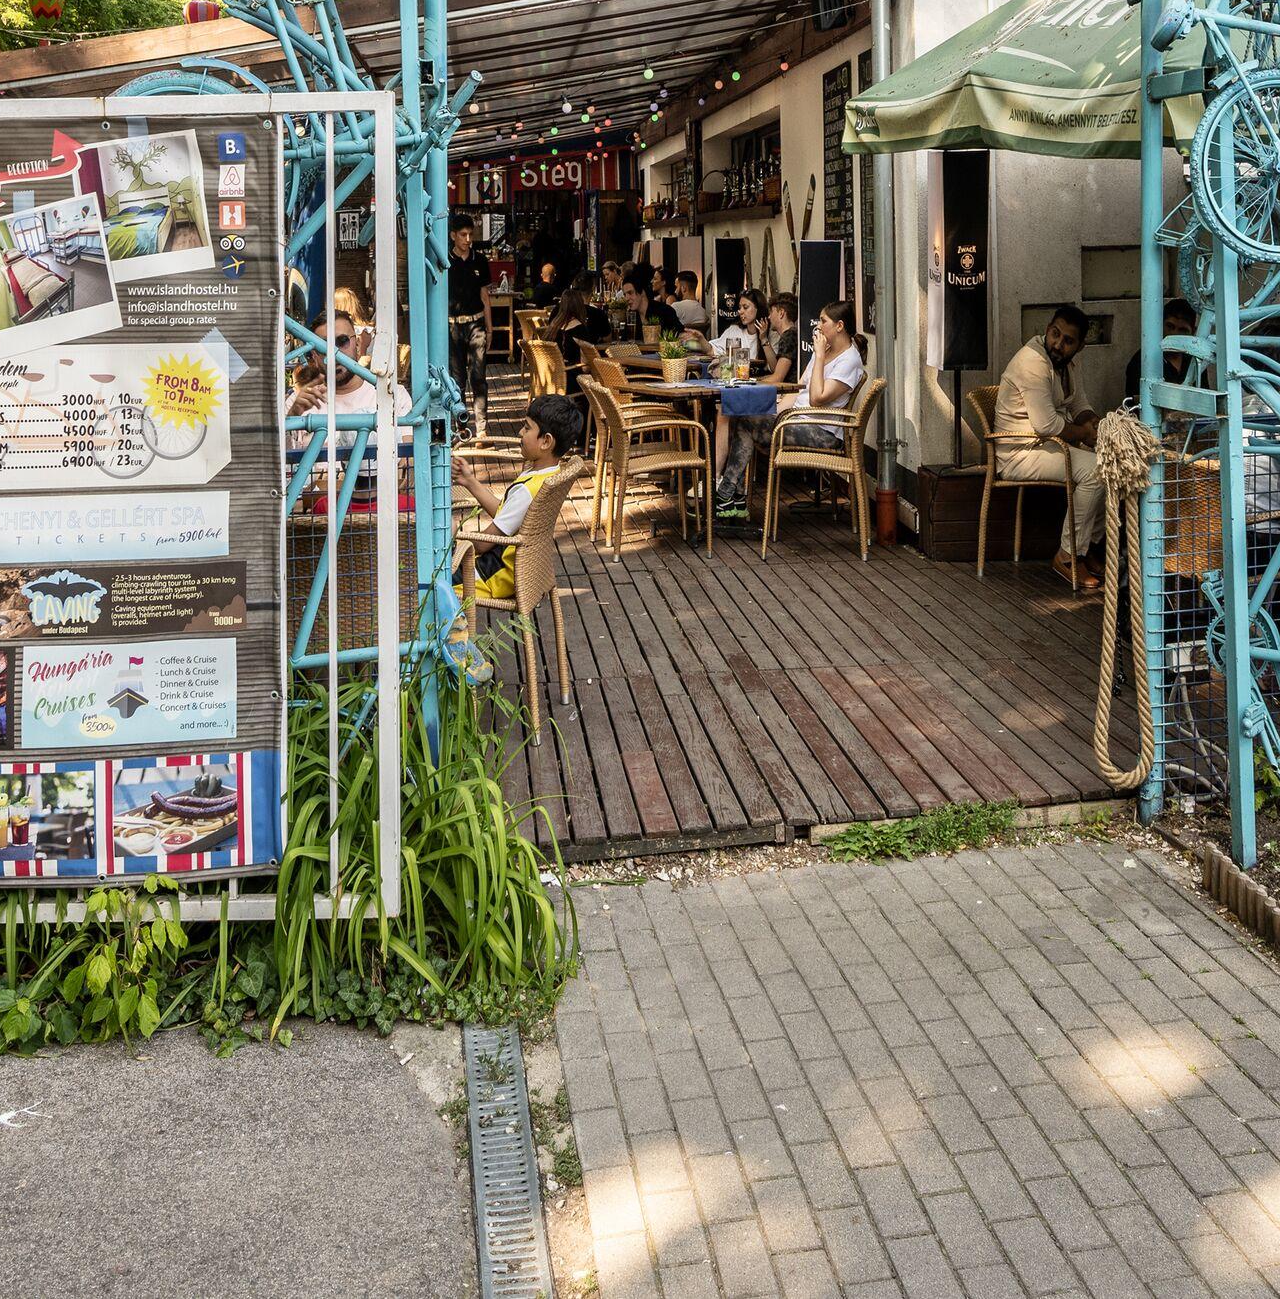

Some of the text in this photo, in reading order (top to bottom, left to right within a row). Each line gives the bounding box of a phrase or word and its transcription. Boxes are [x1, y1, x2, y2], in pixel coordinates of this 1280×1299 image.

[7, 159, 49, 176] RECEPTION
[948, 271, 985, 285] UNICUM
[128, 284, 238, 296] www.islandhostel.hu
[128, 300, 236, 312] info@islandhostel.hu
[128, 316, 216, 326] for special group rates
[156, 374, 210, 394] FROM 8AM
[164, 390, 195, 405] TO 7PM
[86, 503, 167, 528] GELLÉRT
[172, 507, 205, 526] SPA
[222, 576, 236, 584] long
[145, 586, 173, 595] labyrinth
[125, 594, 148, 602] longest
[115, 604, 172, 613] Caving equipment
[139, 610, 162, 618] helmet
[177, 608, 193, 617] light)
[214, 617, 233, 625] 9000
[59, 626, 88, 634] Budapest
[160, 655, 217, 664] Coffee Cruise
[28, 650, 114, 682] Hungária
[160, 667, 216, 676] Lunch Cruise
[160, 678, 219, 688] Dinner Cruise
[160, 690, 214, 700] Drink Cruise
[34, 692, 96, 720] Cruises
[160, 701, 226, 712] Concert Cruises
[180, 722, 194, 730] and
